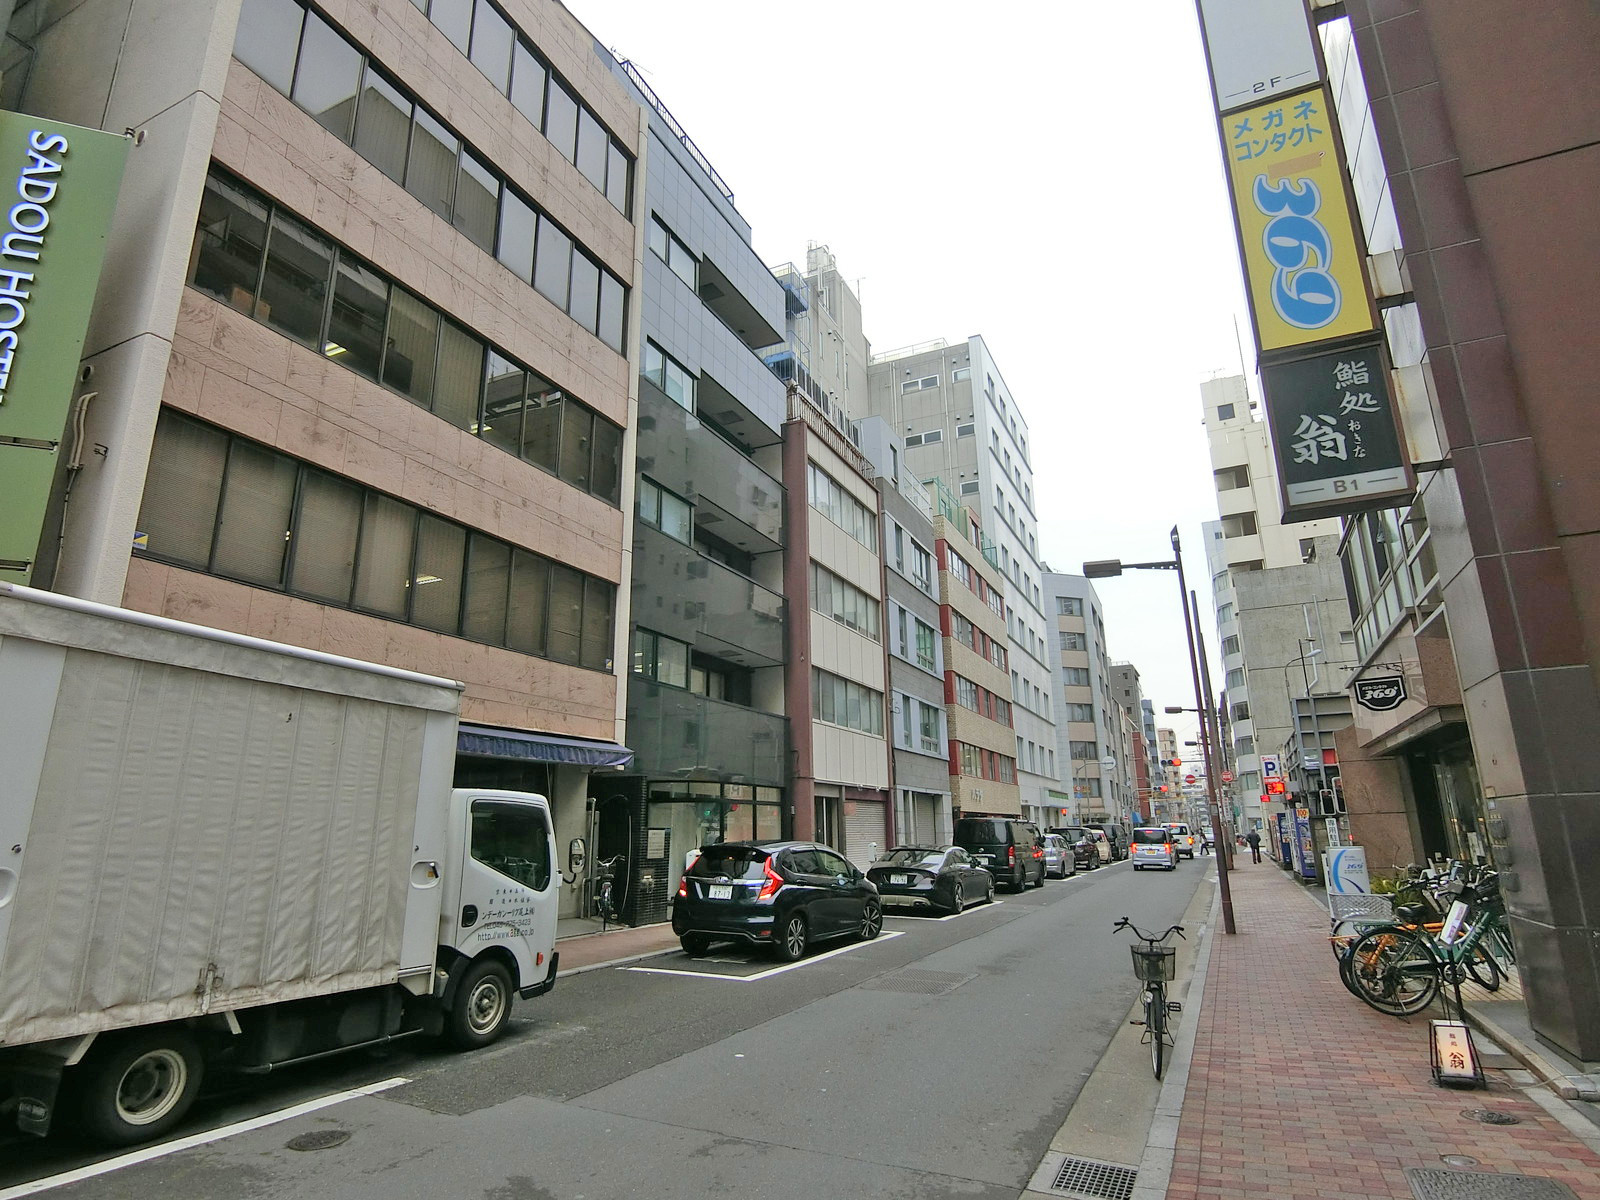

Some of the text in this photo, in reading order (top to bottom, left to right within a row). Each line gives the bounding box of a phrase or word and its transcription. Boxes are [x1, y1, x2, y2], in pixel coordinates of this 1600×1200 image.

[1252, 76, 1281, 94] 2F
[1234, 101, 1318, 139] メガネ
[1235, 123, 1323, 161] コンタクト
[2, 129, 69, 260] SADOU
[1252, 174, 1342, 330] 369
[1291, 414, 1348, 465] 翁
[1347, 419, 1366, 458] おきな
[1333, 479, 1359, 494] B1
[1363, 688, 1397, 700] 369
[1264, 761, 1276, 776] P
